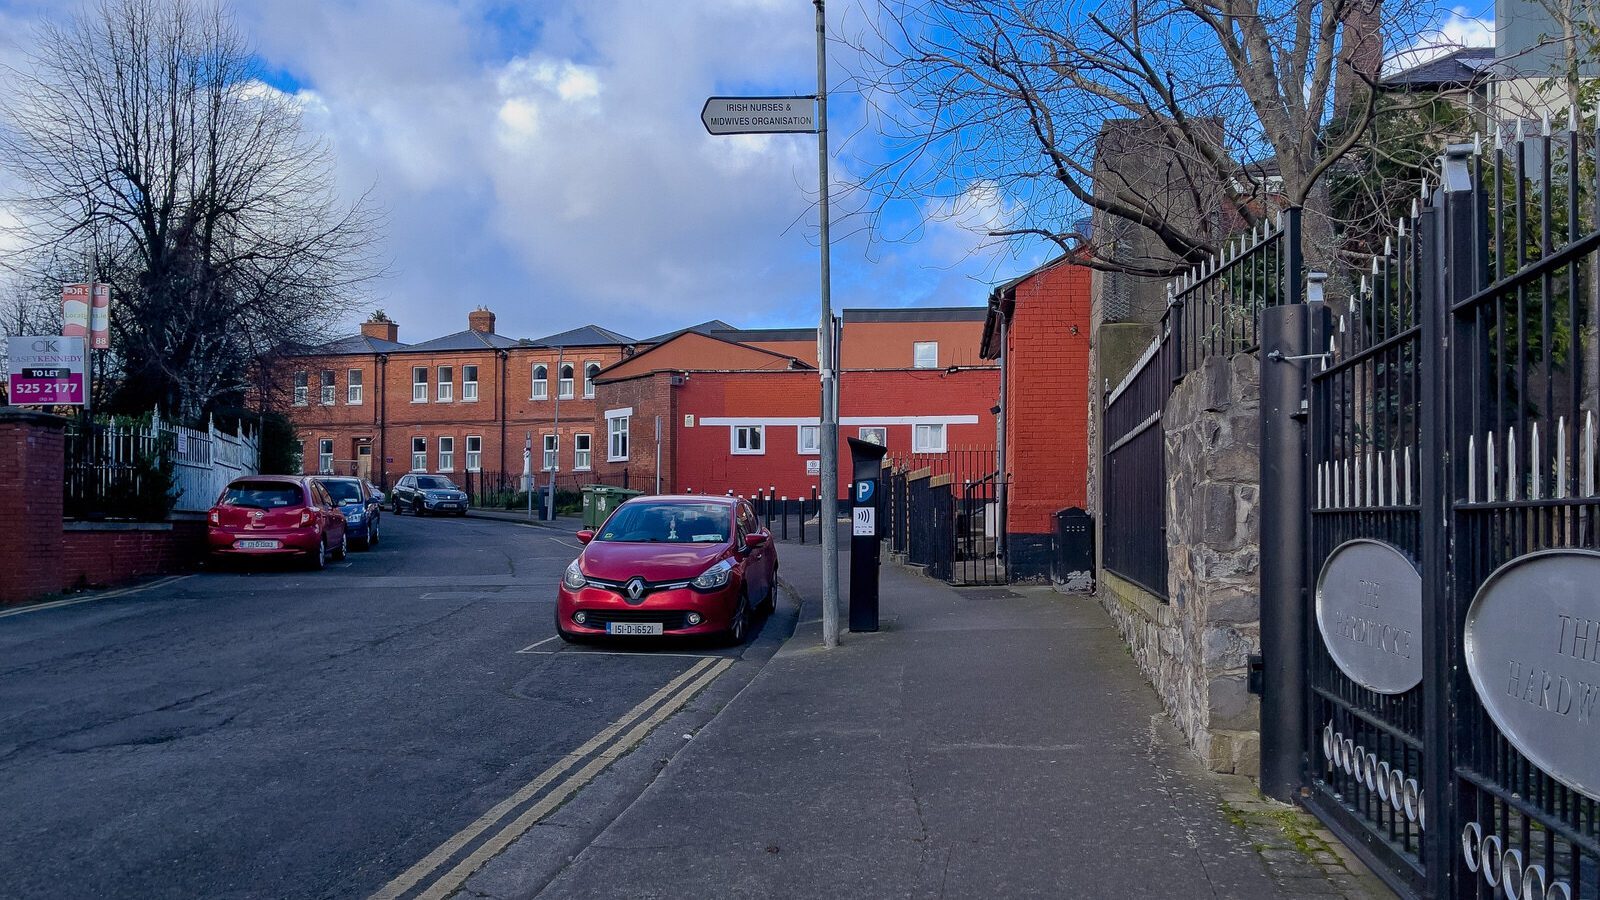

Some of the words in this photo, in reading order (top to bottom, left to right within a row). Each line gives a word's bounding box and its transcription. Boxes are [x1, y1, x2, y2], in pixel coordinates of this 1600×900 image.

[726, 103, 748, 112] IRISH
[750, 103, 784, 112] NURSES
[785, 103, 792, 112] &
[710, 117, 750, 126] MIDWIVES
[751, 116, 812, 126] ORGANISATION
[95, 337, 106, 345] 88
[16, 383, 40, 394] 525
[44, 383, 78, 393] 2177
[859, 482, 869, 499] P
[614, 625, 654, 634] 151-D-16521
